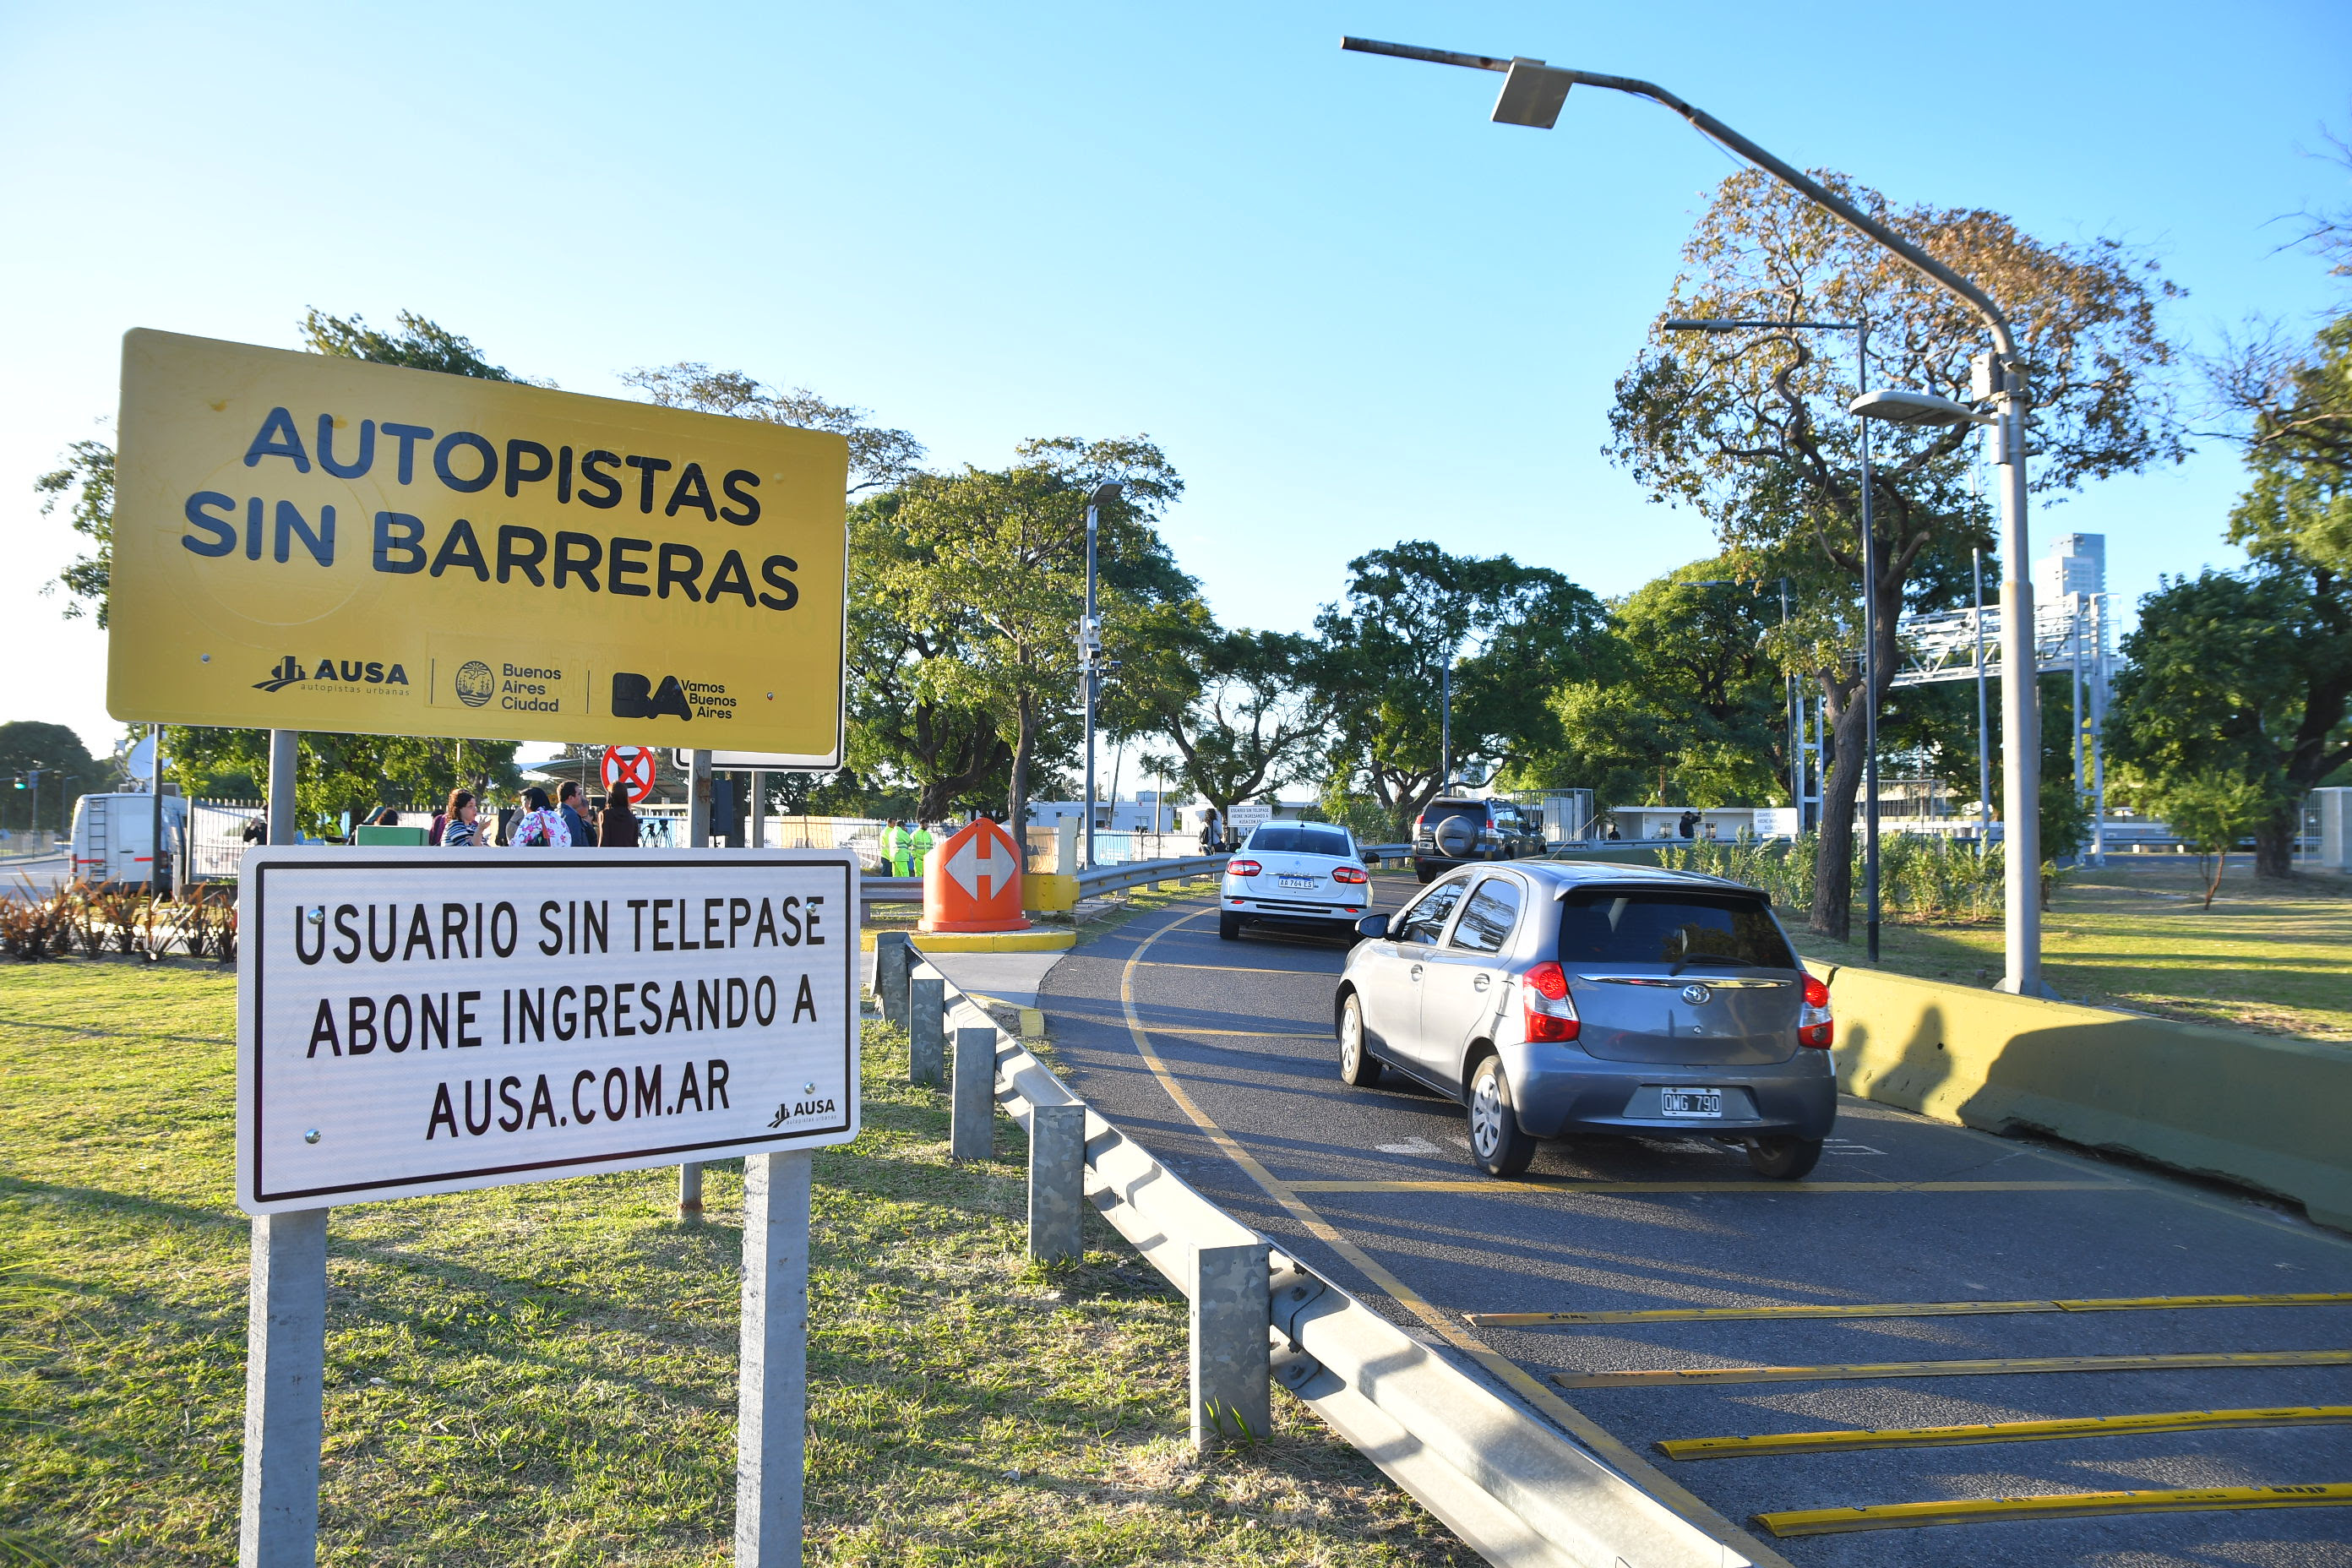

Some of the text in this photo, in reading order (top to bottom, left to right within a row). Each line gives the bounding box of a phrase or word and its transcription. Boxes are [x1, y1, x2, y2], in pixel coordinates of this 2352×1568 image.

[244, 407, 760, 526] AUTOPISTAS
[182, 492, 799, 612] SIN BARRERAS
[314, 659, 409, 685] AUSA
[503, 663, 561, 680] Buenos
[301, 683, 410, 696] autopistas urbanas
[502, 680, 546, 695] Aires
[681, 679, 726, 694] Vamos
[502, 696, 559, 712] Ciudad
[612, 672, 693, 721] BA
[689, 694, 738, 707] Buenos
[696, 706, 732, 719] Aires
[297, 896, 825, 965] USUARIO SIN TELEPASE
[307, 974, 817, 1058] ABONE INGRESANDO A
[427, 1059, 730, 1141] AUSA.COM.AR
[794, 1099, 836, 1116] AUSA
[1664, 1094, 1719, 1112] OWG 790
[787, 1117, 814, 1125] autopistas
